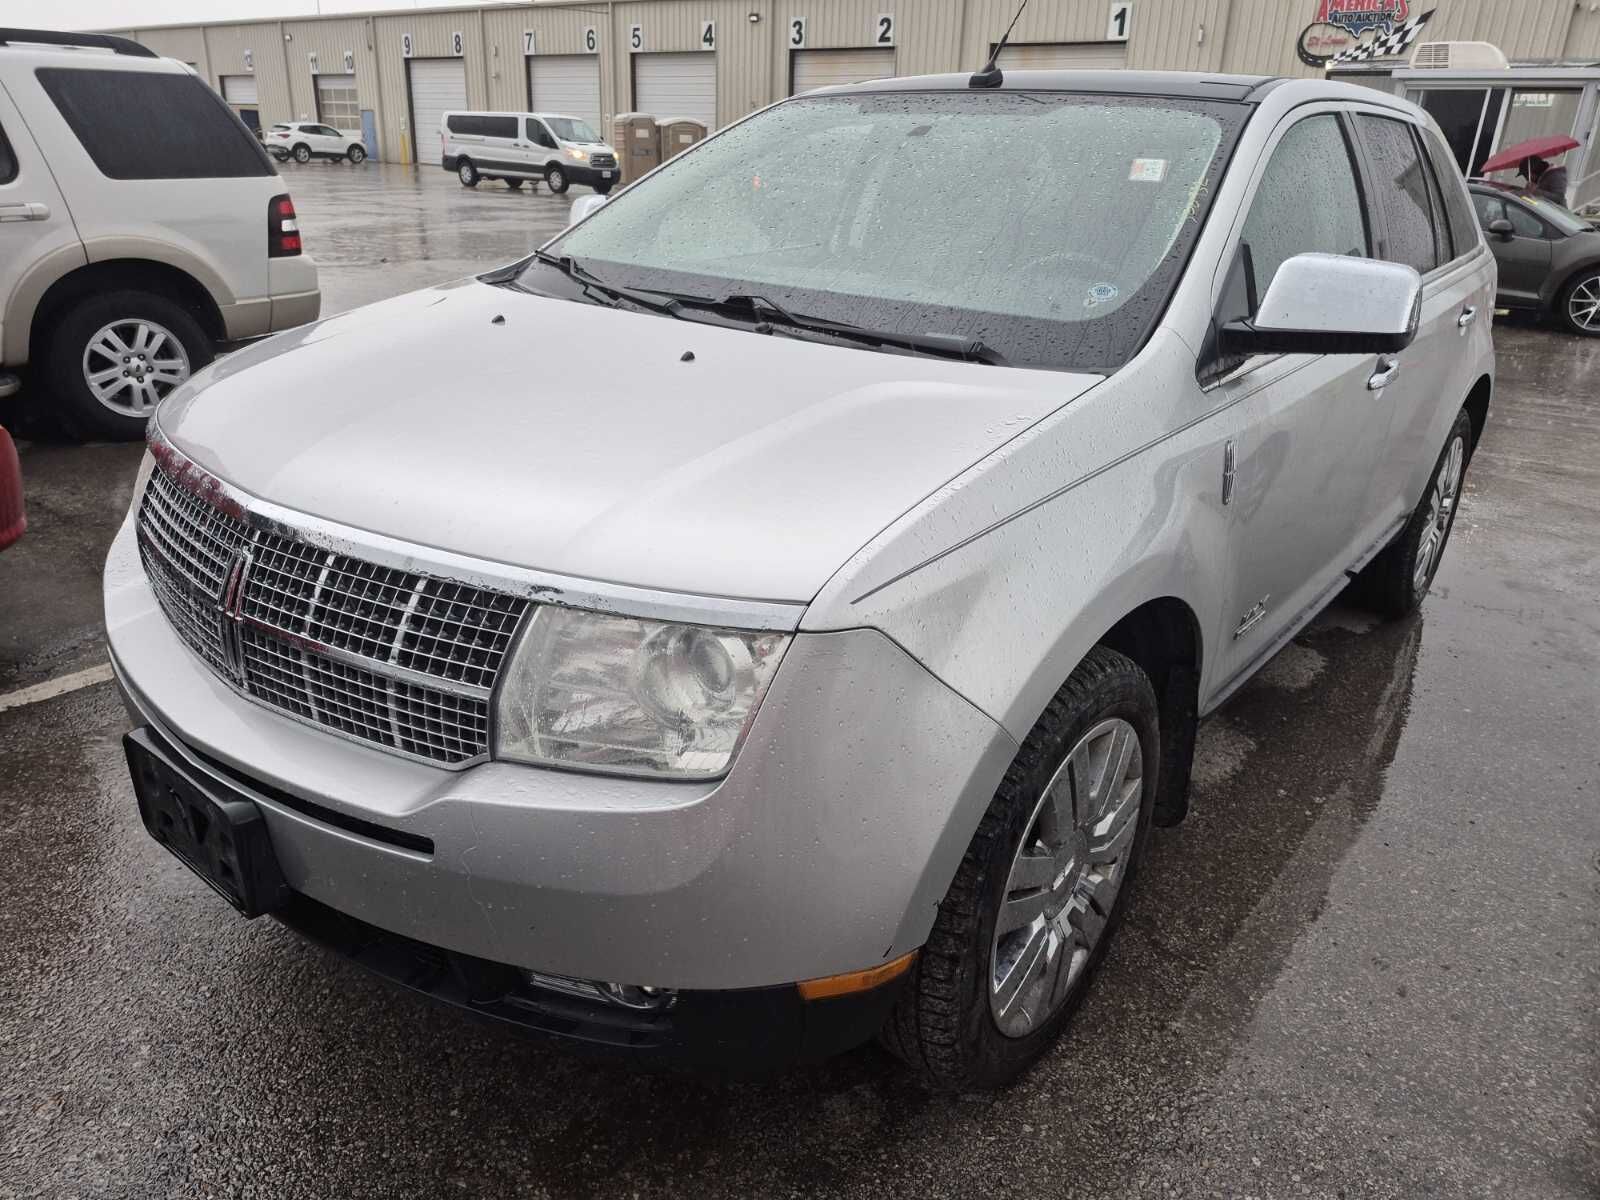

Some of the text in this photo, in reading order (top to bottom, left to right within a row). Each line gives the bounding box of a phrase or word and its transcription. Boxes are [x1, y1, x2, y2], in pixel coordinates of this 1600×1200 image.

[1114, 7, 1127, 36] 1
[1331, 12, 1391, 23] AUTO AUCTION
[586, 29, 596, 50] 6
[631, 27, 641, 48] 5
[702, 24, 714, 46] 4
[791, 21, 804, 44] 3
[878, 18, 892, 42] 2
[404, 36, 411, 54] 9
[454, 34, 462, 53] 8
[525, 32, 533, 51] 7
